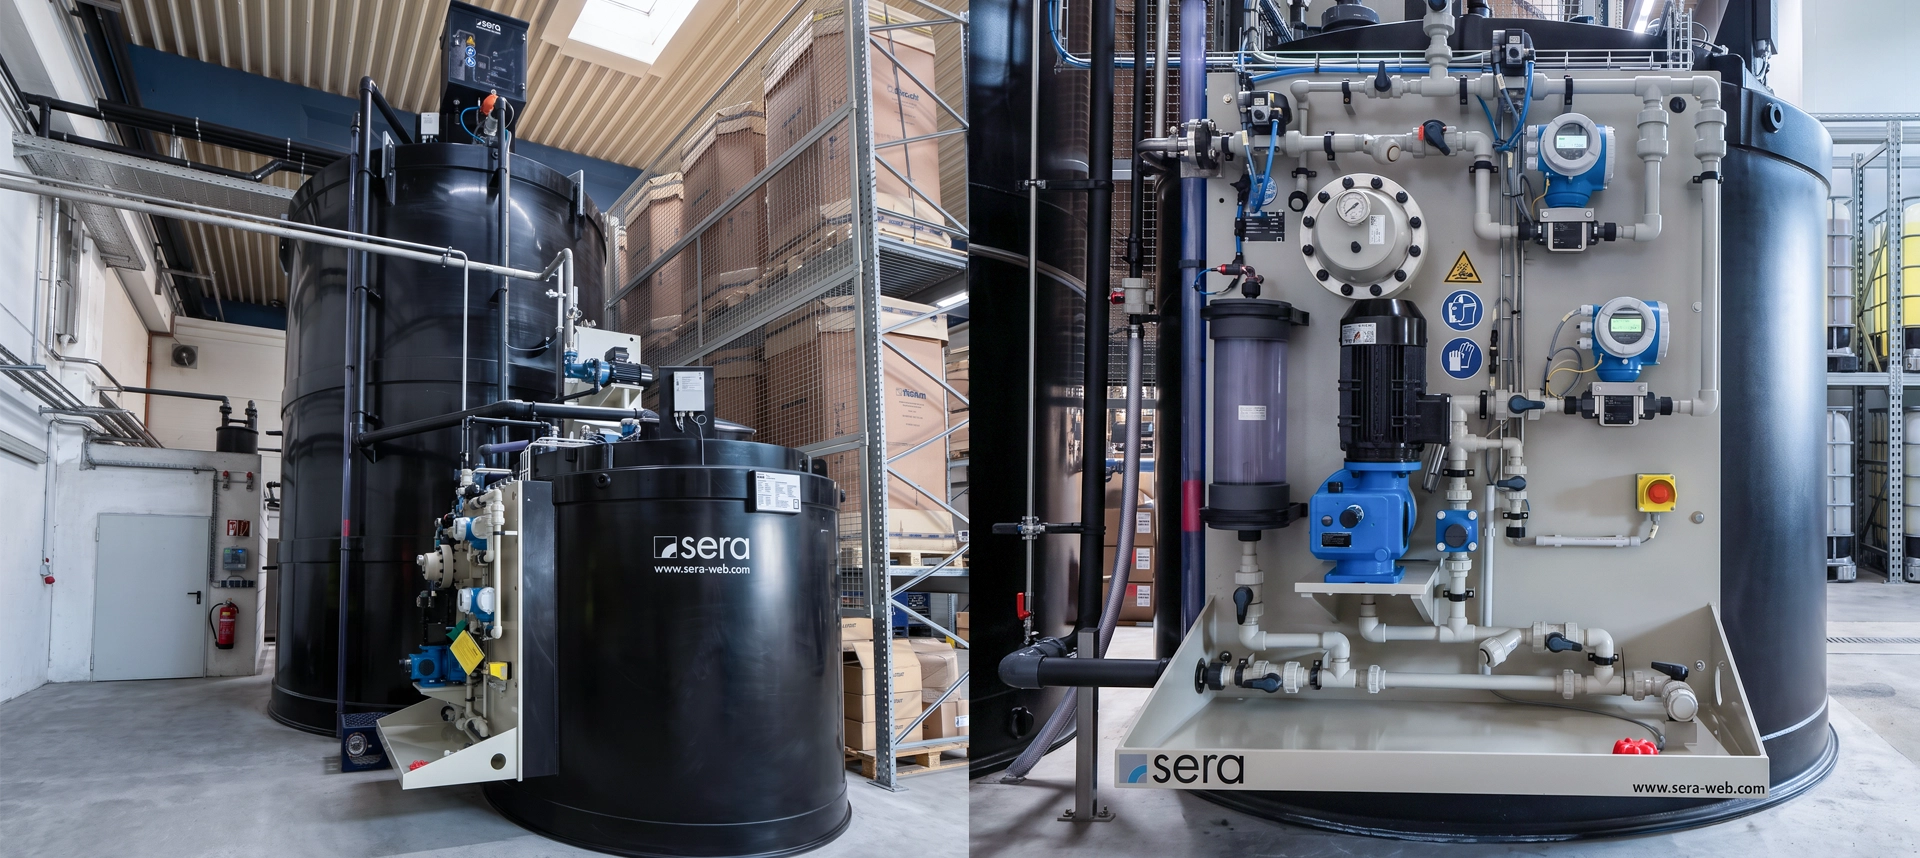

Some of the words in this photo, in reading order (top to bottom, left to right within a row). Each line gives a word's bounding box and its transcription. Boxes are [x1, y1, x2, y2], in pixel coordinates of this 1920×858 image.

[481, 20, 501, 31] sera
[680, 536, 750, 560] sera
[654, 563, 750, 574] www.sera-web.com
[1152, 754, 1244, 784] sera
[1632, 781, 1765, 794] www.sera-web.com
